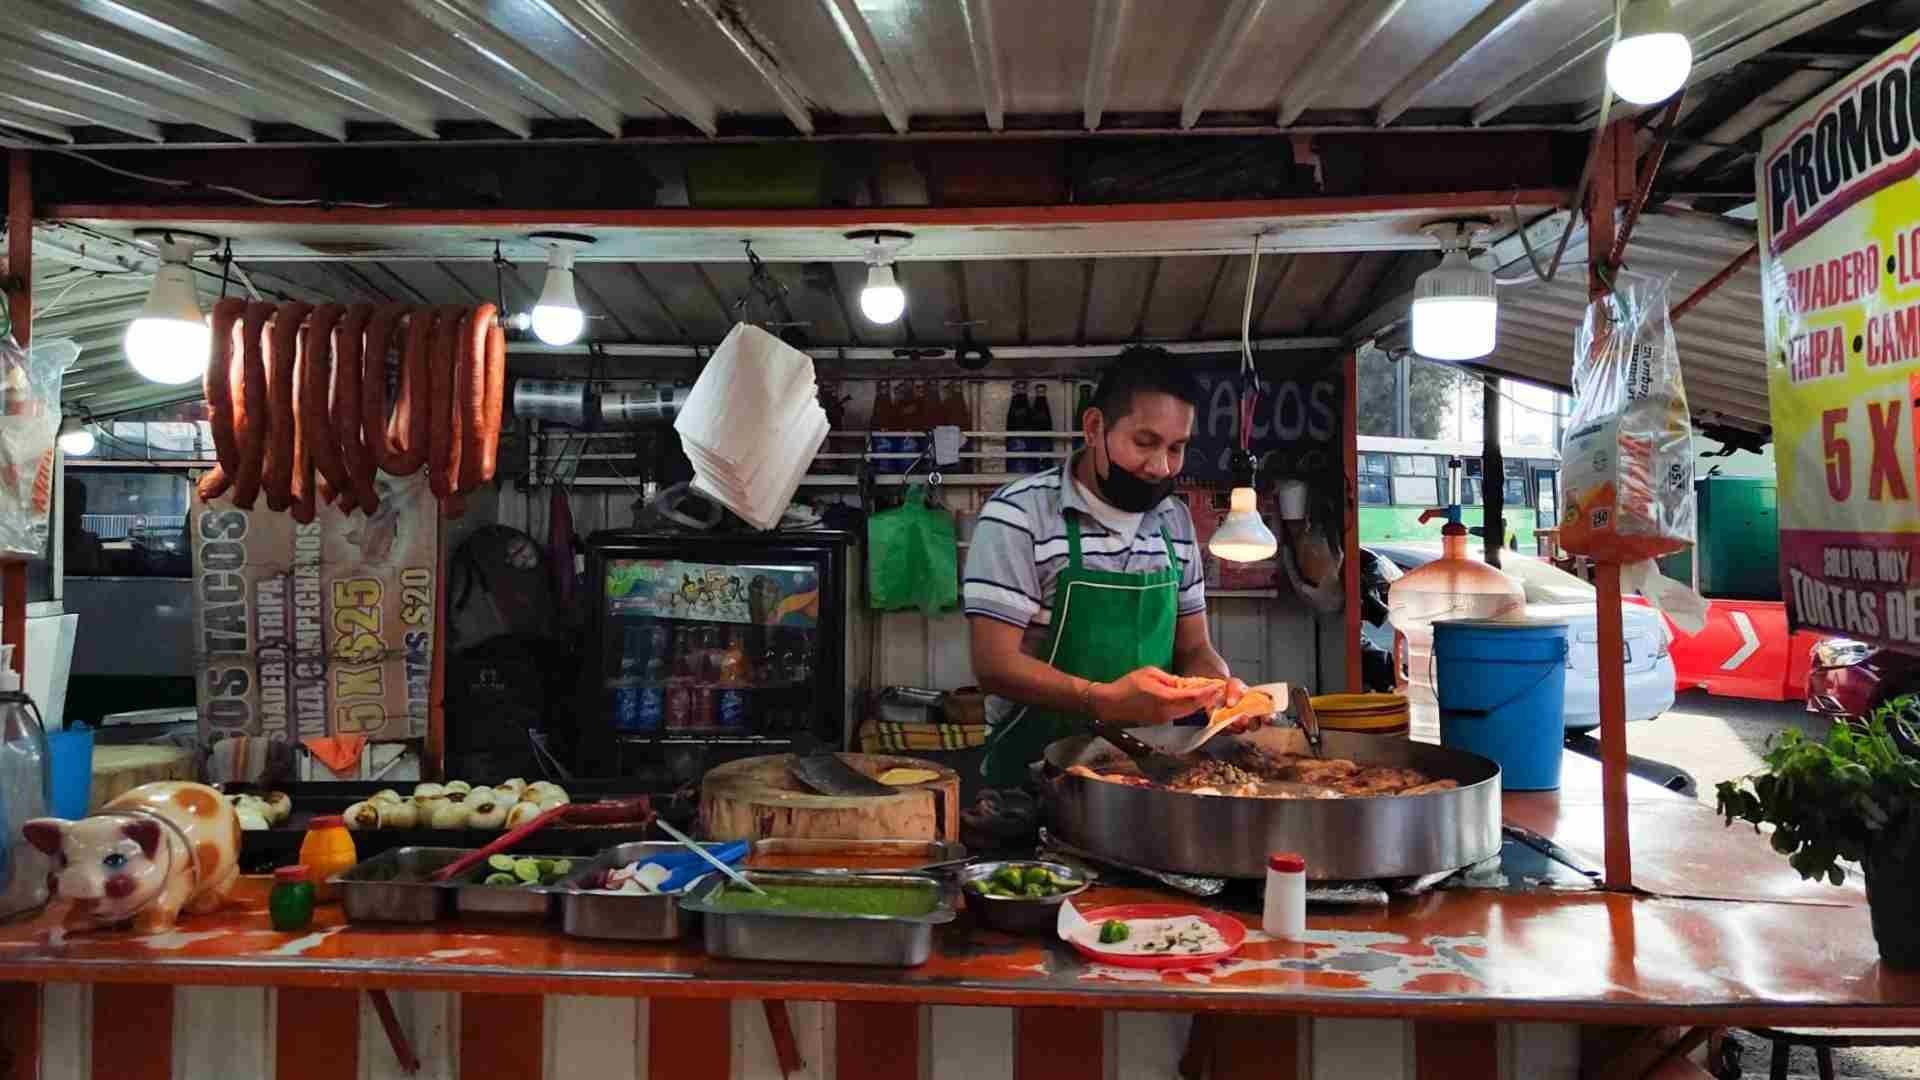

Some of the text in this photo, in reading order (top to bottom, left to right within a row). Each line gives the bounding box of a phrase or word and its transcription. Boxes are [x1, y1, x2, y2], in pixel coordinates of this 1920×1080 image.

[1789, 303, 1920, 382] TRIPA CAM
[1822, 400, 1909, 502] 5 X
[200, 511, 250, 655] TACOS
[1789, 567, 1880, 637] TORTAS
[333, 578, 387, 733] 5 X $25
[401, 567, 432, 738] TORTAS $20
